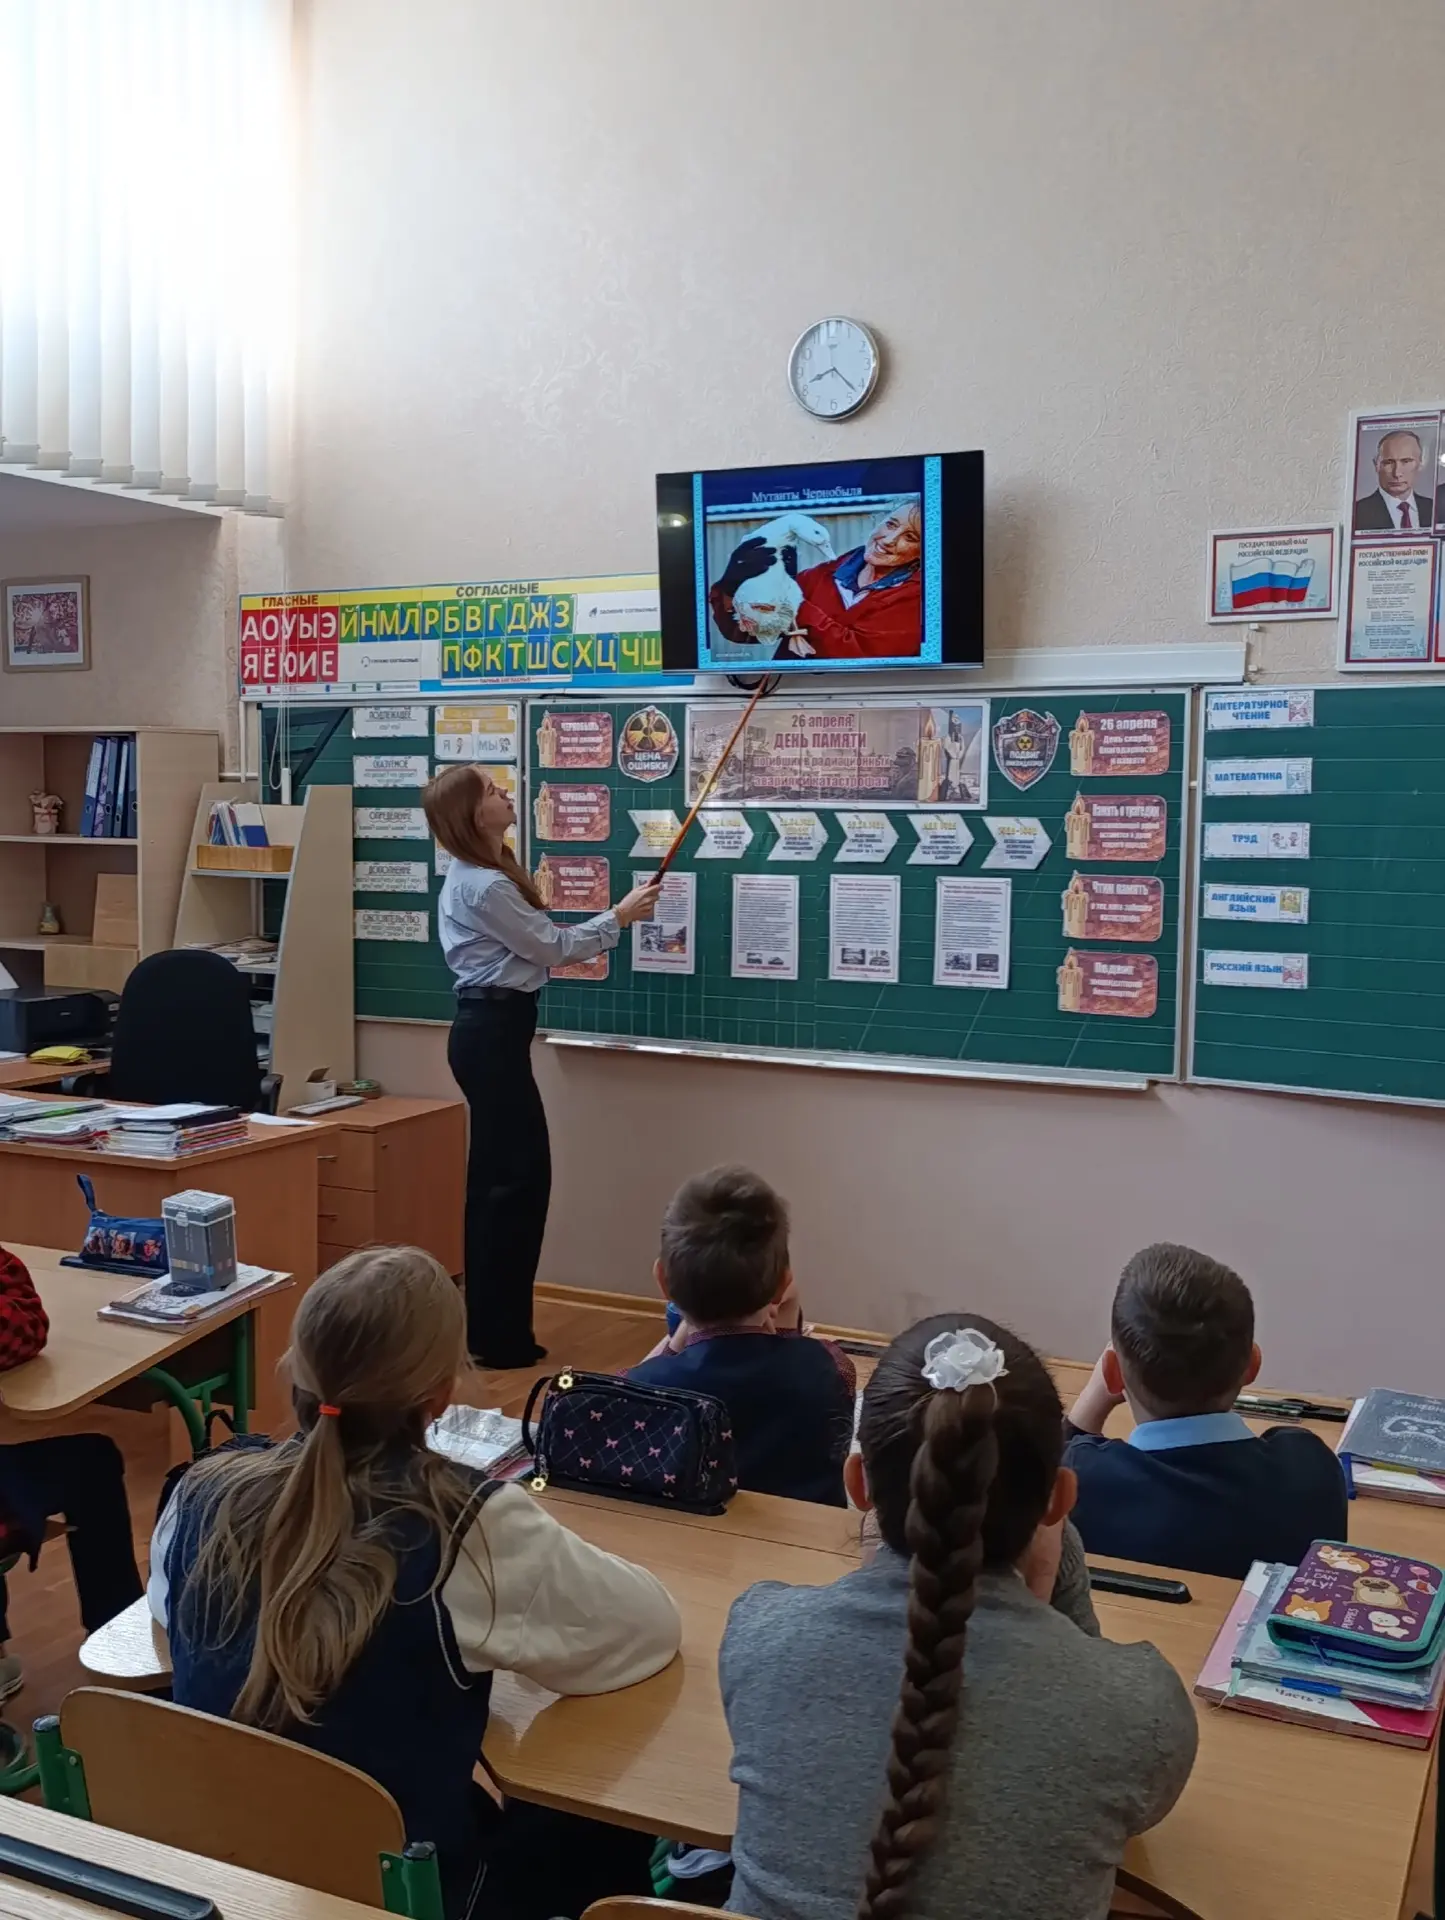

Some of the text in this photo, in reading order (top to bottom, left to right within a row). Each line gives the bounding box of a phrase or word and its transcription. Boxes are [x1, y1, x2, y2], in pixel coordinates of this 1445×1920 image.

[456, 583, 539, 598] СОГЛАСНЫЕ
[262, 595, 319, 607] ГЛАСНЫЕ
[1213, 700, 1289, 711] ЛИТЕРАТУРНОЕ
[1232, 711, 1271, 720] ЧТЕНИЕ
[791, 714, 852, 730] 26 апреля
[1100, 718, 1157, 731] 26 апреля
[479, 740, 497, 751] МЫ
[774, 732, 867, 751] ДЕНЬ ПАМЯТИ
[634, 752, 661, 760] ЦЕНА
[627, 761, 669, 770] ОШИБКИ
[1214, 772, 1283, 782] МАТЕМАТИКА
[1232, 834, 1258, 844] ТРУД
[1211, 892, 1276, 903] АНГЛИЙСКИЙ
[1228, 904, 1256, 913] ЯЗЫК
[1210, 962, 1283, 973] РУССКИЙ ЯЗЫК
[1313, 1572, 1338, 1582] CAN
